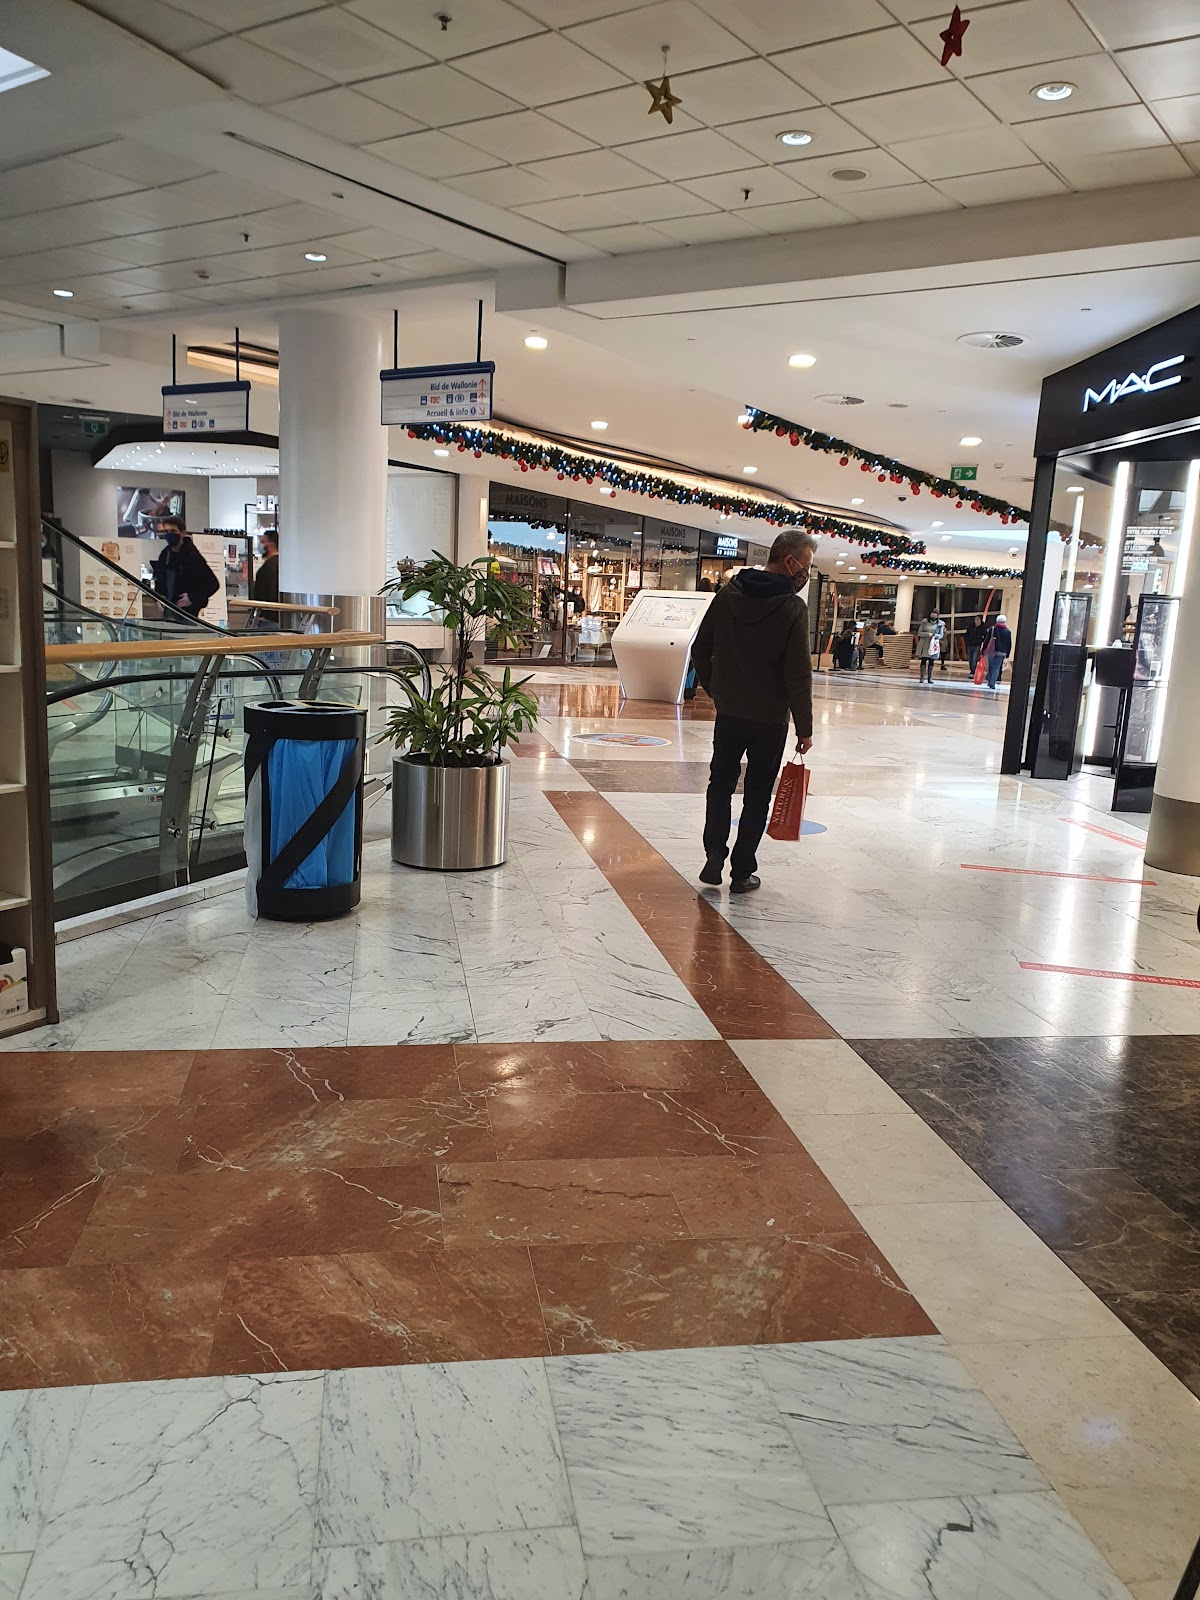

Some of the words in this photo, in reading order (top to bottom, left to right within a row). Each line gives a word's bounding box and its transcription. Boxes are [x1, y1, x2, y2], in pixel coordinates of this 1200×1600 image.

[430, 383, 440, 391] Bld
[441, 382, 449, 390] de
[451, 380, 477, 389] Wallonie
[426, 409, 448, 418] Accueil
[449, 408, 454, 416] &
[505, 493, 548, 509] MAISONS
[661, 526, 686, 538] MAISONS
[717, 537, 739, 548] MAISONS
[772, 787, 787, 824] NATURE
[783, 777, 793, 788] &
[1090, 970, 1135, 980] GARDEZ
